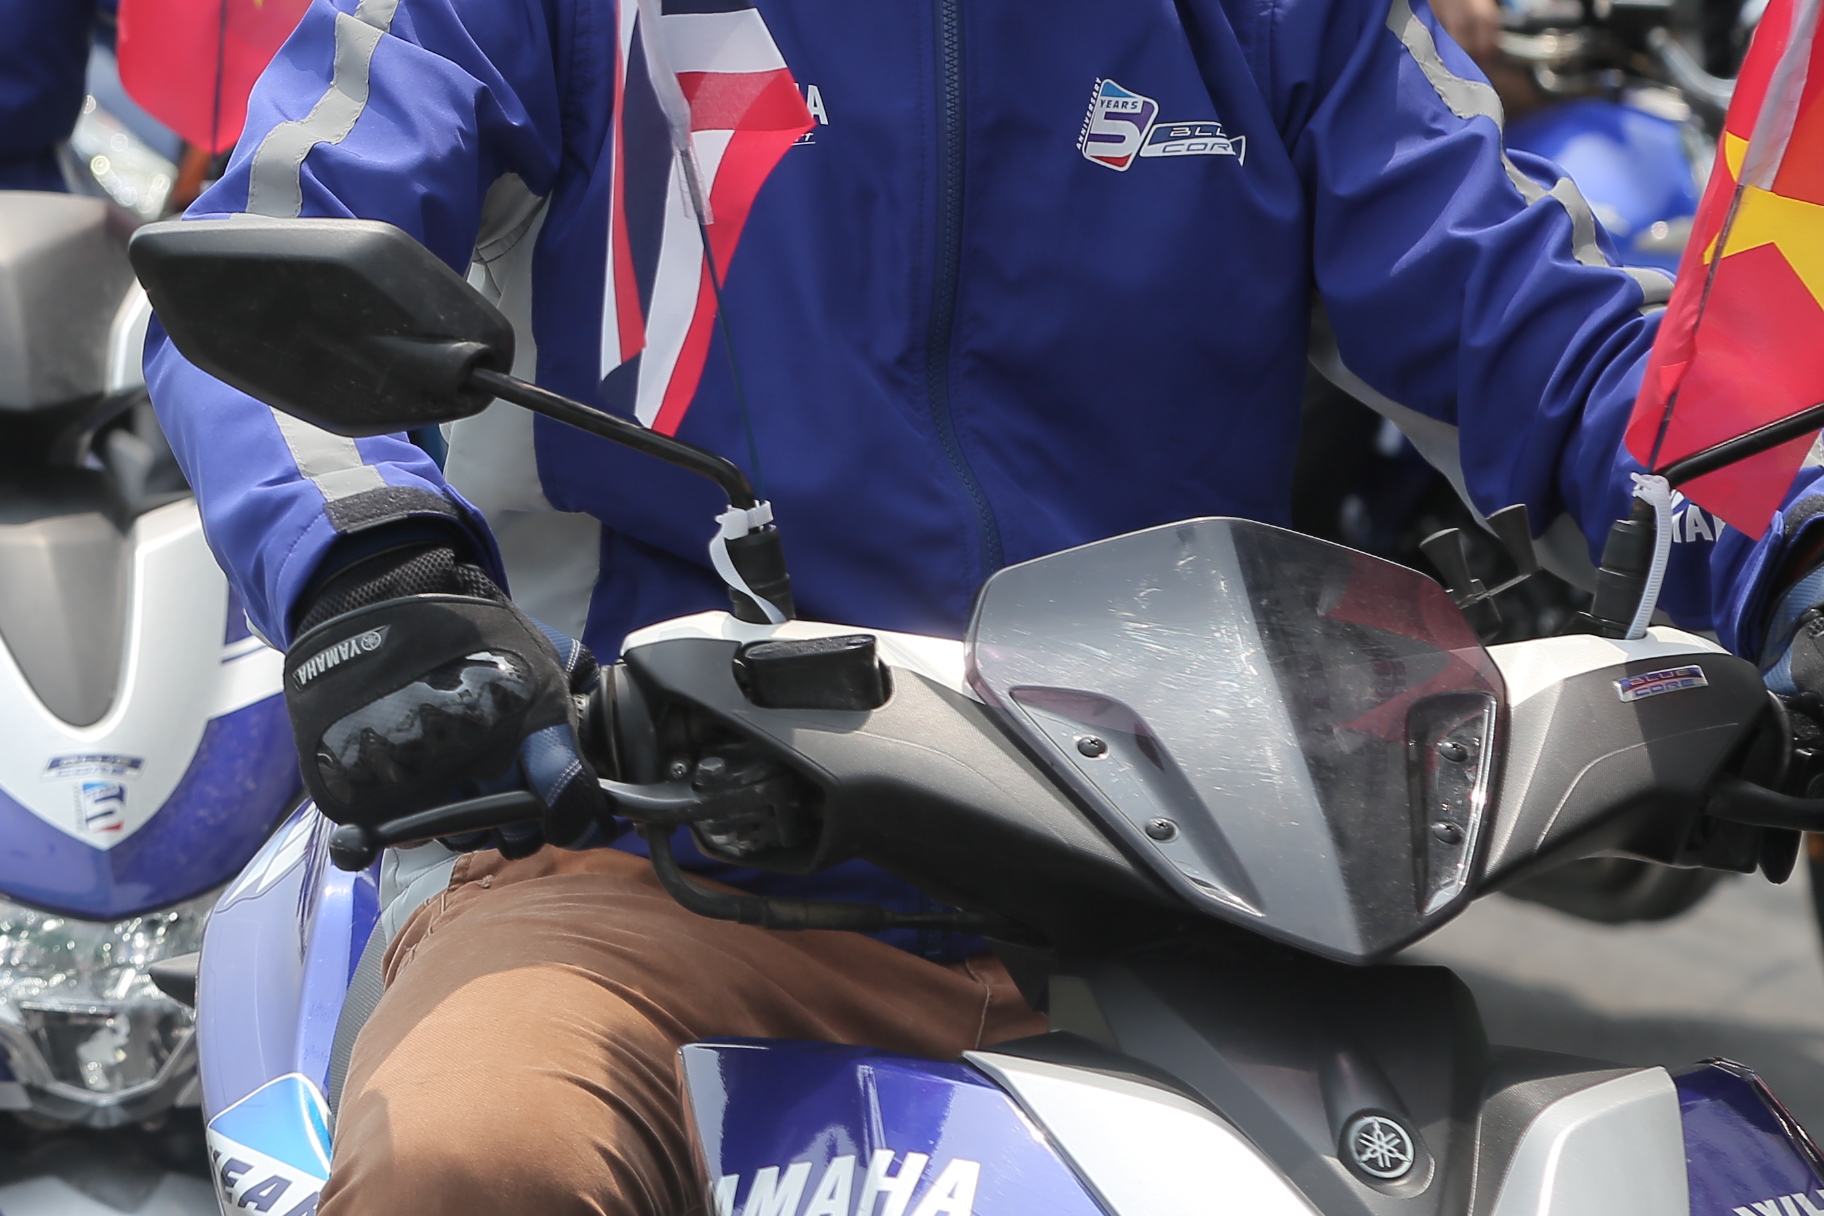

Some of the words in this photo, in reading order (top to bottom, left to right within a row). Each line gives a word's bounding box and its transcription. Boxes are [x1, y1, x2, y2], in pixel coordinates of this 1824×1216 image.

[1076, 77, 1102, 151] ANNIVERSARY
[1099, 98, 1139, 110] YEARS
[1169, 126, 1228, 138] BL
[1161, 142, 1232, 154] COR
[297, 639, 362, 685] YAMAHA
[714, 1148, 981, 1216] AMAHA
